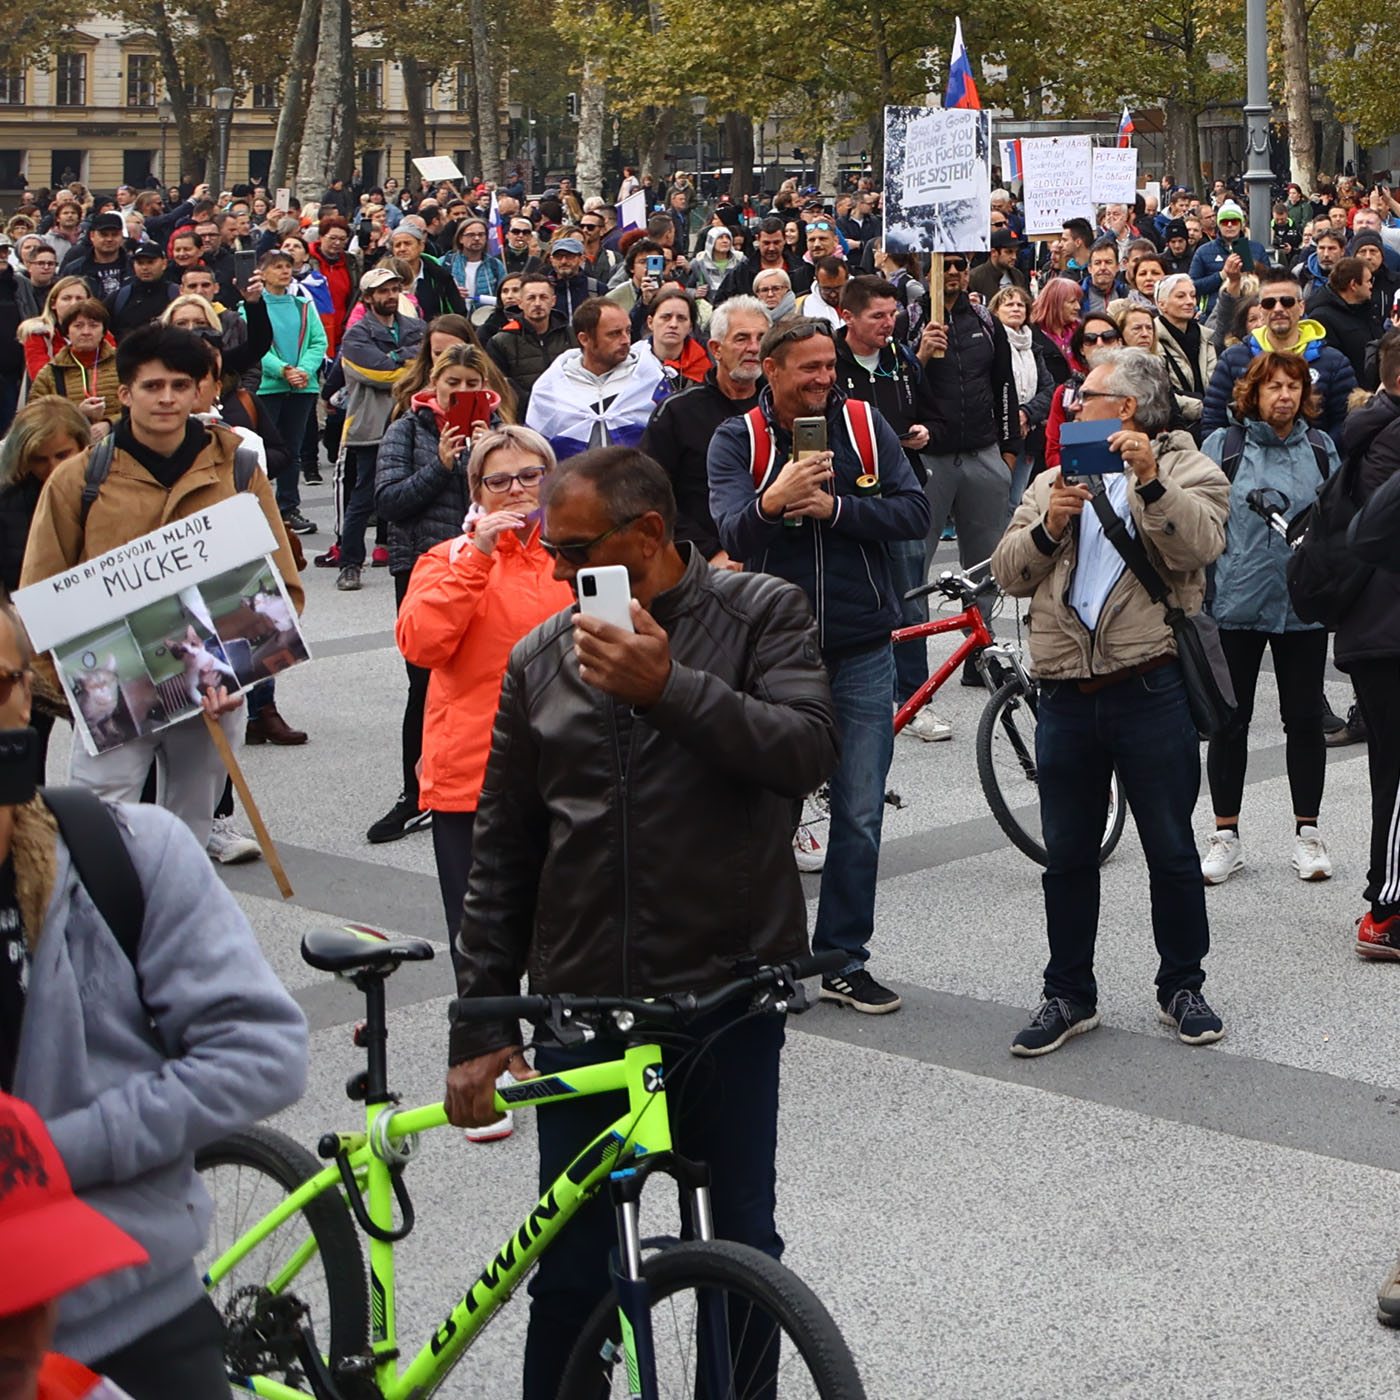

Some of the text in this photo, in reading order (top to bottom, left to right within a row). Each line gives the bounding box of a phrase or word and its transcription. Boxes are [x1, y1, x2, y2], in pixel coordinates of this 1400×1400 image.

[950, 128, 973, 143] YOU
[907, 144, 973, 169] EVER FUCKED
[906, 159, 975, 188] THE SYSTEM?
[1033, 175, 1085, 188] SLOVENIJE
[52, 574, 80, 593] KDO
[100, 539, 156, 571] POSVOJIL
[163, 515, 213, 545] MLADE
